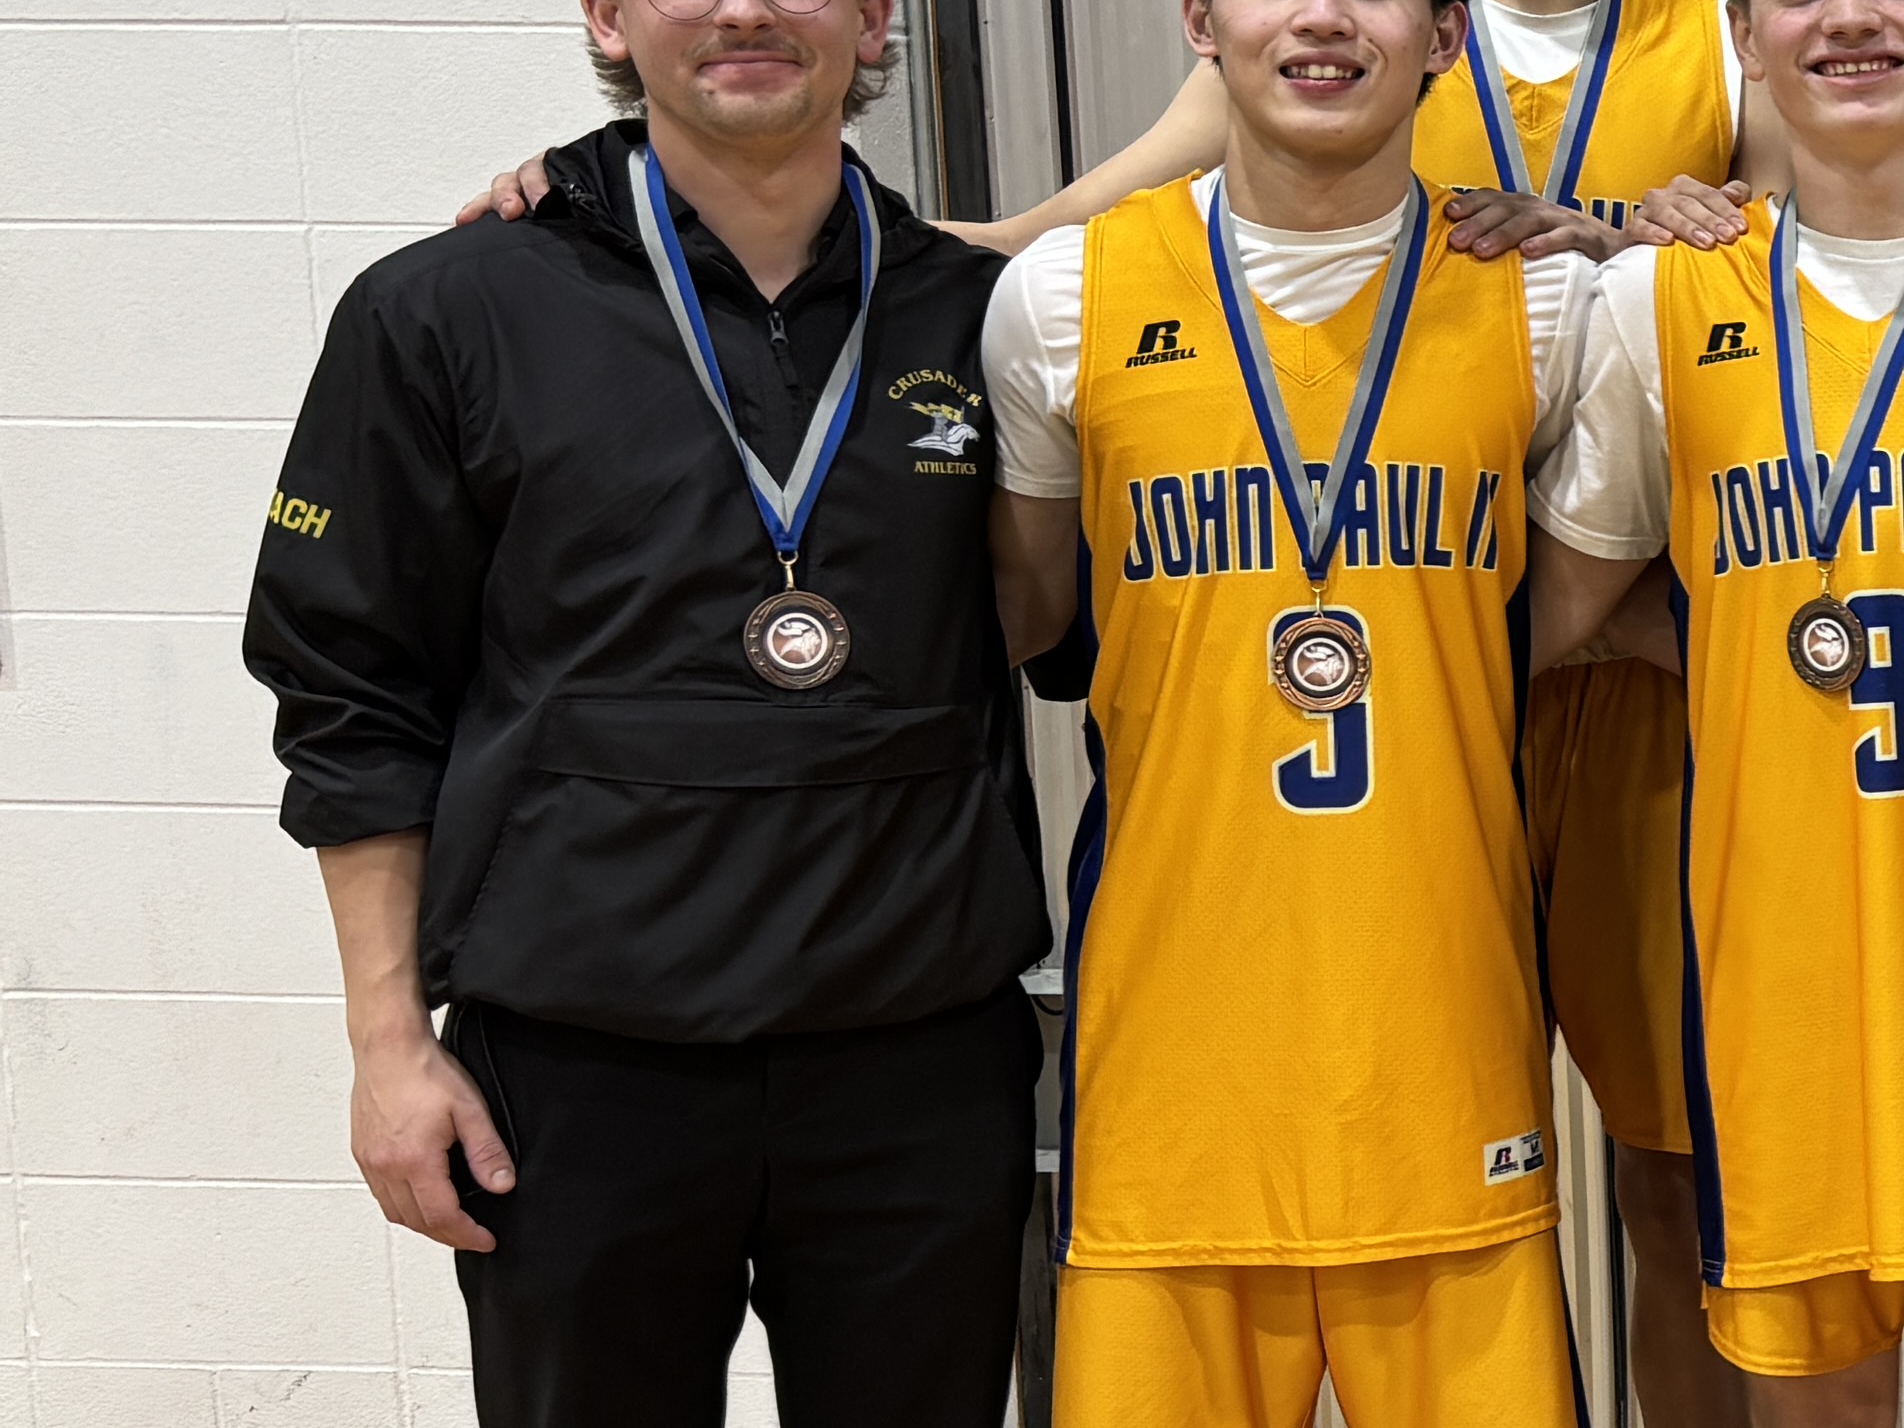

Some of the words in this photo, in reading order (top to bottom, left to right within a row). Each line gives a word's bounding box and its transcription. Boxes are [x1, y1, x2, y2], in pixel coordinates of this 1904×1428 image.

[1125, 347, 1197, 368] RUSSELL
[1697, 346, 1760, 366] RUSSELL
[888, 369, 983, 407] CRUSADER
[914, 461, 977, 475] ATHLETICS
[1123, 463, 1276, 582] JOHN
